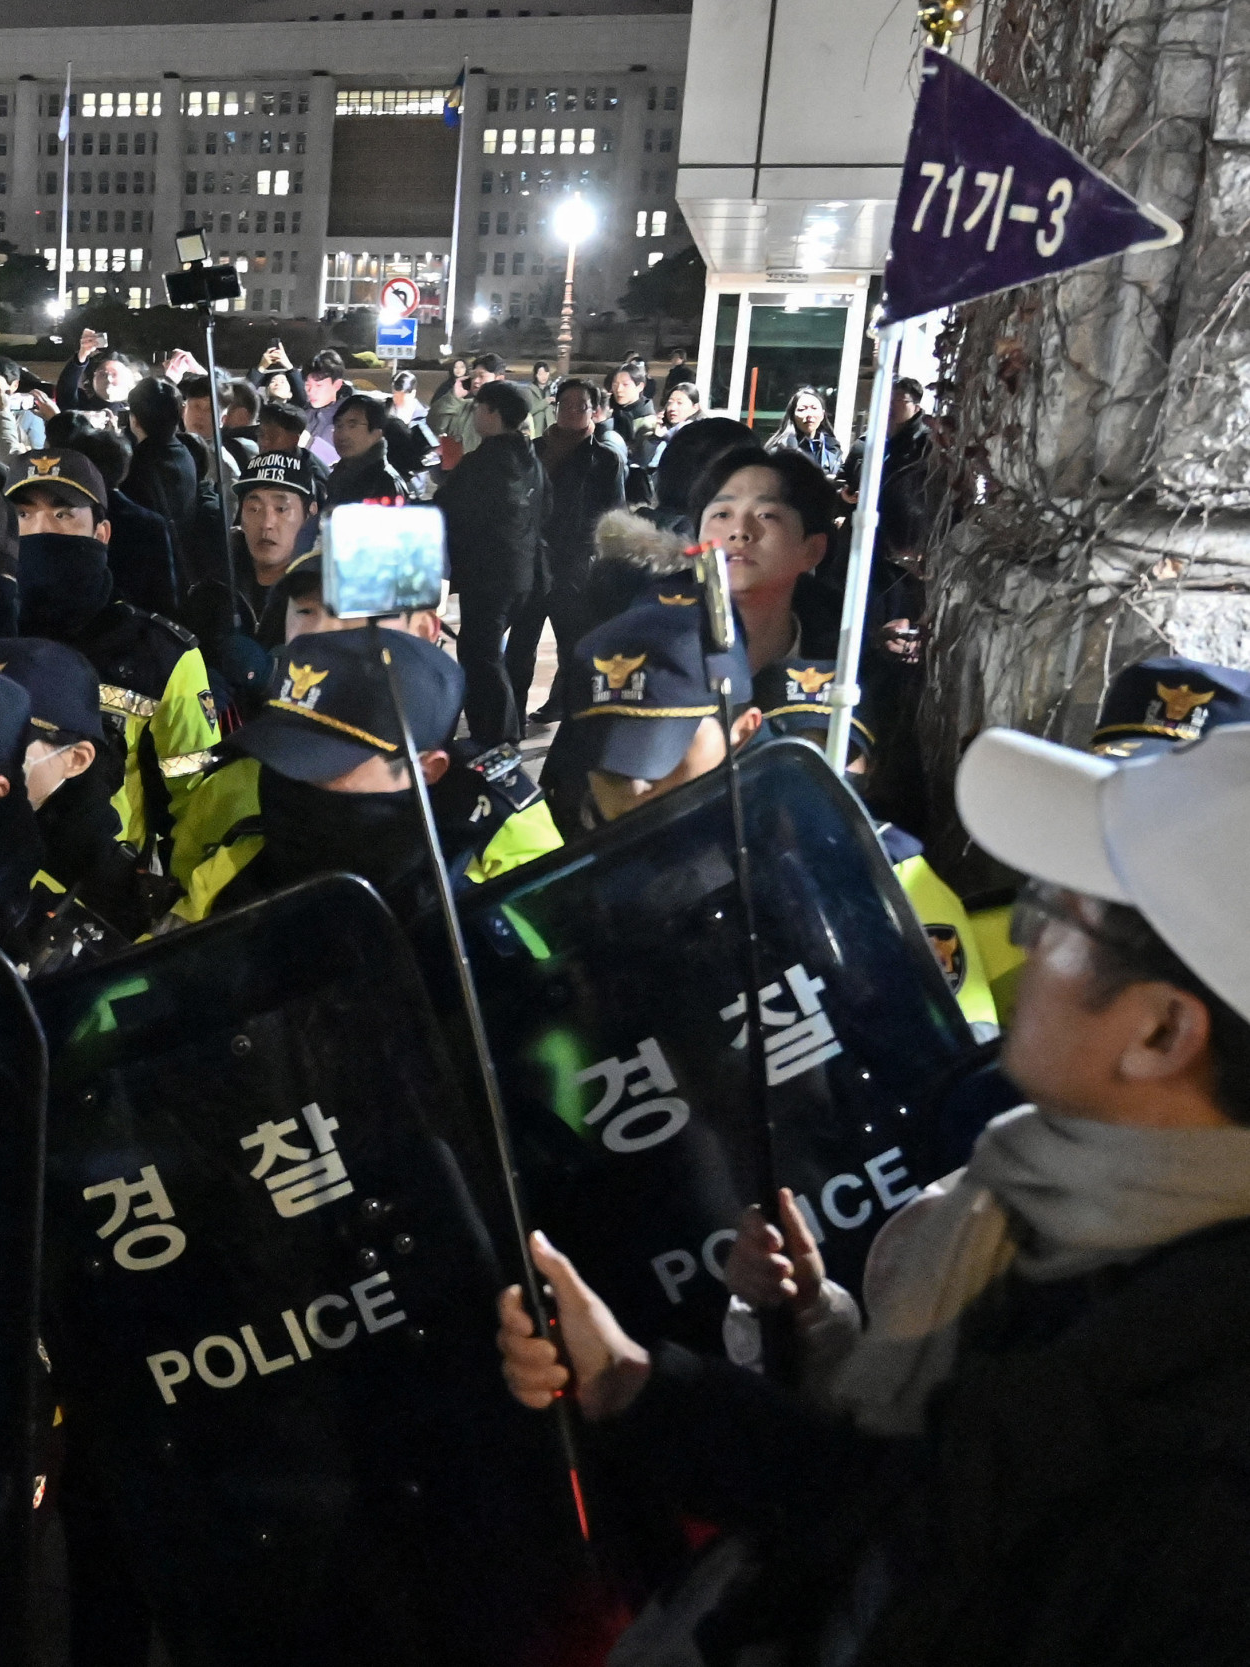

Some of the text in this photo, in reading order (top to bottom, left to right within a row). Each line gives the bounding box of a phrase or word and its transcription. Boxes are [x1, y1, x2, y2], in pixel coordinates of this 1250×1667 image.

[911, 161, 1073, 258] 71기-3
[247, 454, 301, 470] BROOKLYN
[256, 468, 285, 481] NETS
[572, 963, 843, 1153] 경 찰
[83, 1102, 354, 1271] 경 찰
[146, 1270, 407, 1405] POLICE
